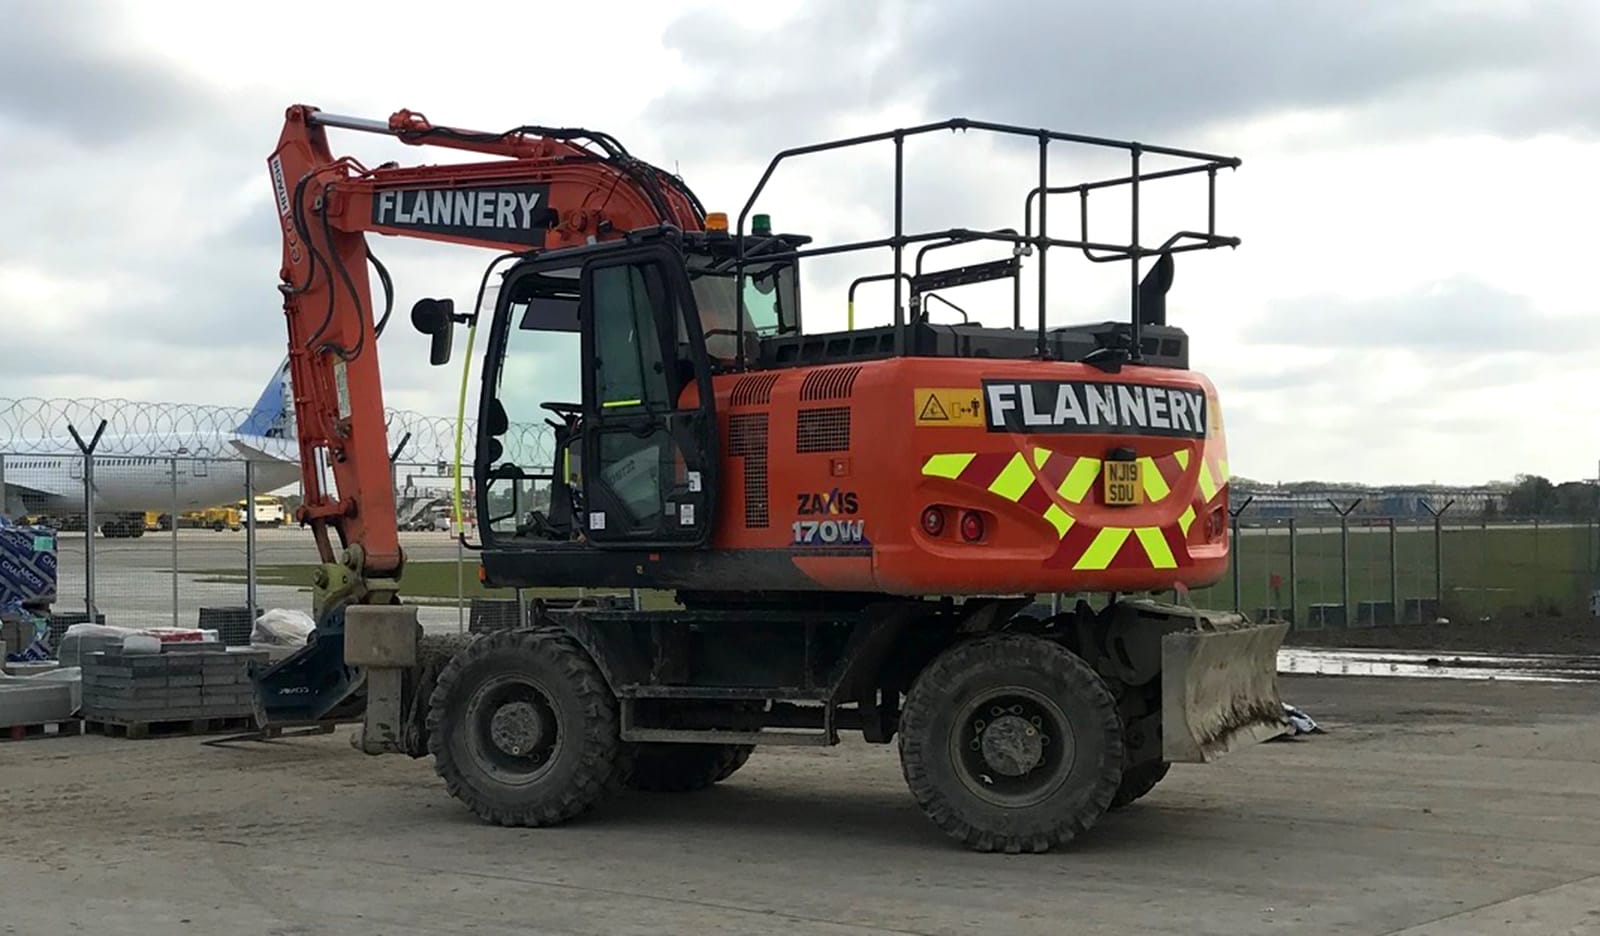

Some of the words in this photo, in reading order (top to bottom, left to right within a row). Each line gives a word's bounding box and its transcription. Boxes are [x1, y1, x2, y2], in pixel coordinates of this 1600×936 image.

[273, 160, 288, 211] HITACHI
[378, 190, 541, 230] FLANNERY
[987, 384, 1204, 433] FLANNERY
[1109, 463, 1138, 481] NJ19
[797, 488, 859, 515] ZAXIS
[1109, 484, 1134, 502] SDU
[792, 519, 865, 543] 170W
